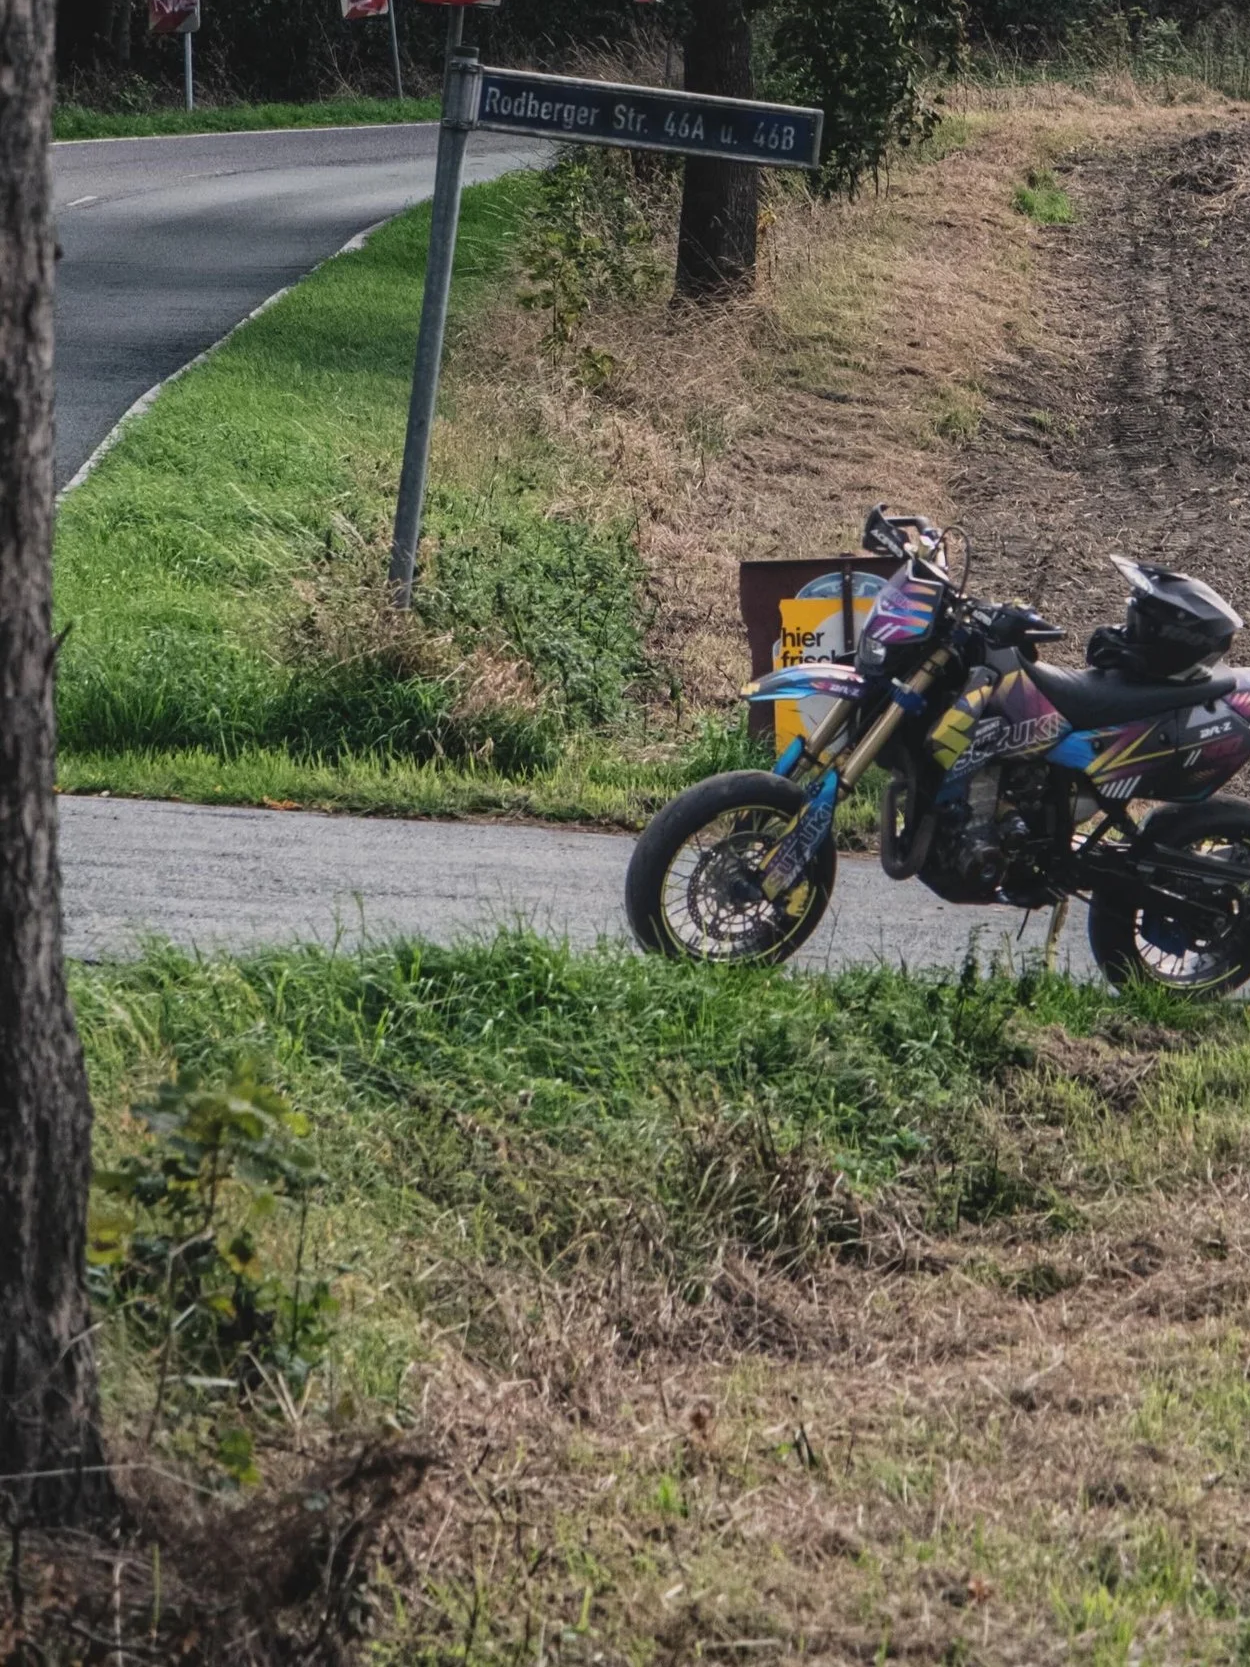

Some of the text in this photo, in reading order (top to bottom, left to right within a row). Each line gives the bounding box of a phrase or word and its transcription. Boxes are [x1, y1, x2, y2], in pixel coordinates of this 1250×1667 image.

[484, 87, 796, 151] Rodberger Str. 46A u. 46B
[782, 627, 825, 648] hier
